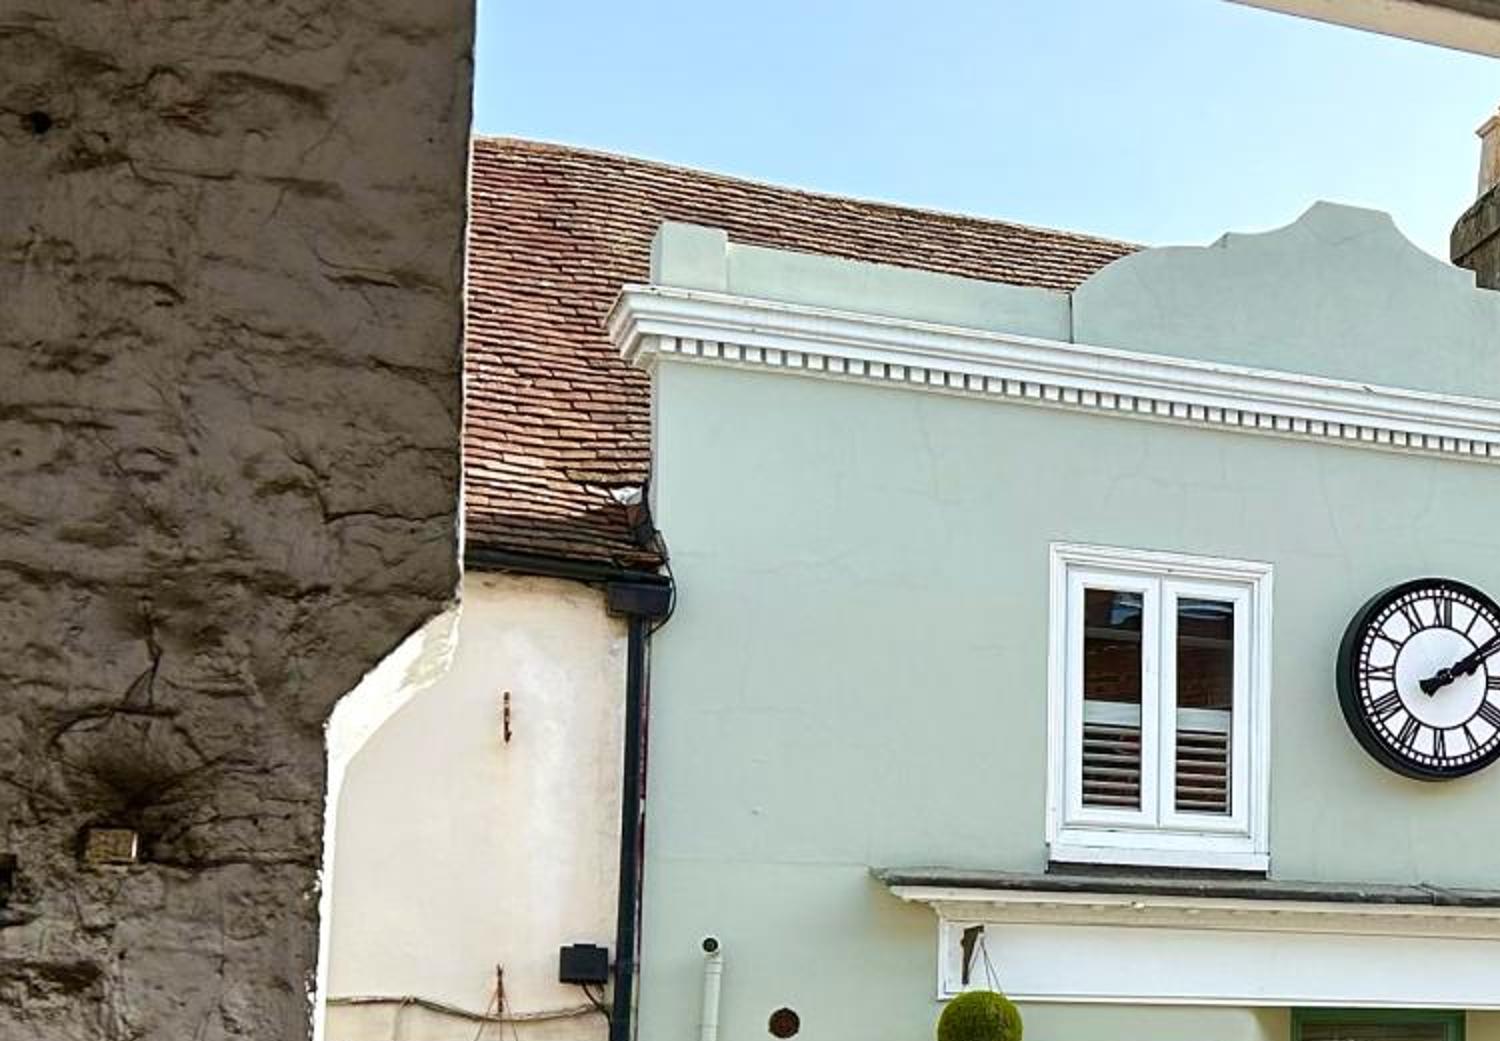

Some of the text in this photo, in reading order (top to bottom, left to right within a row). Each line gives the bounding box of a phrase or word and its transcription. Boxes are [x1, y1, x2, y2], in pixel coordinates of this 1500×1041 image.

[1401, 601, 1425, 632] XI
[1434, 597, 1453, 627] XII
[1466, 610, 1480, 636] I
[1377, 626, 1403, 651] X
[1367, 664, 1395, 682] IX
[1373, 690, 1404, 722] VIII
[1397, 716, 1421, 748] VII
[1433, 728, 1447, 757] VI
[1463, 723, 1481, 752] V
